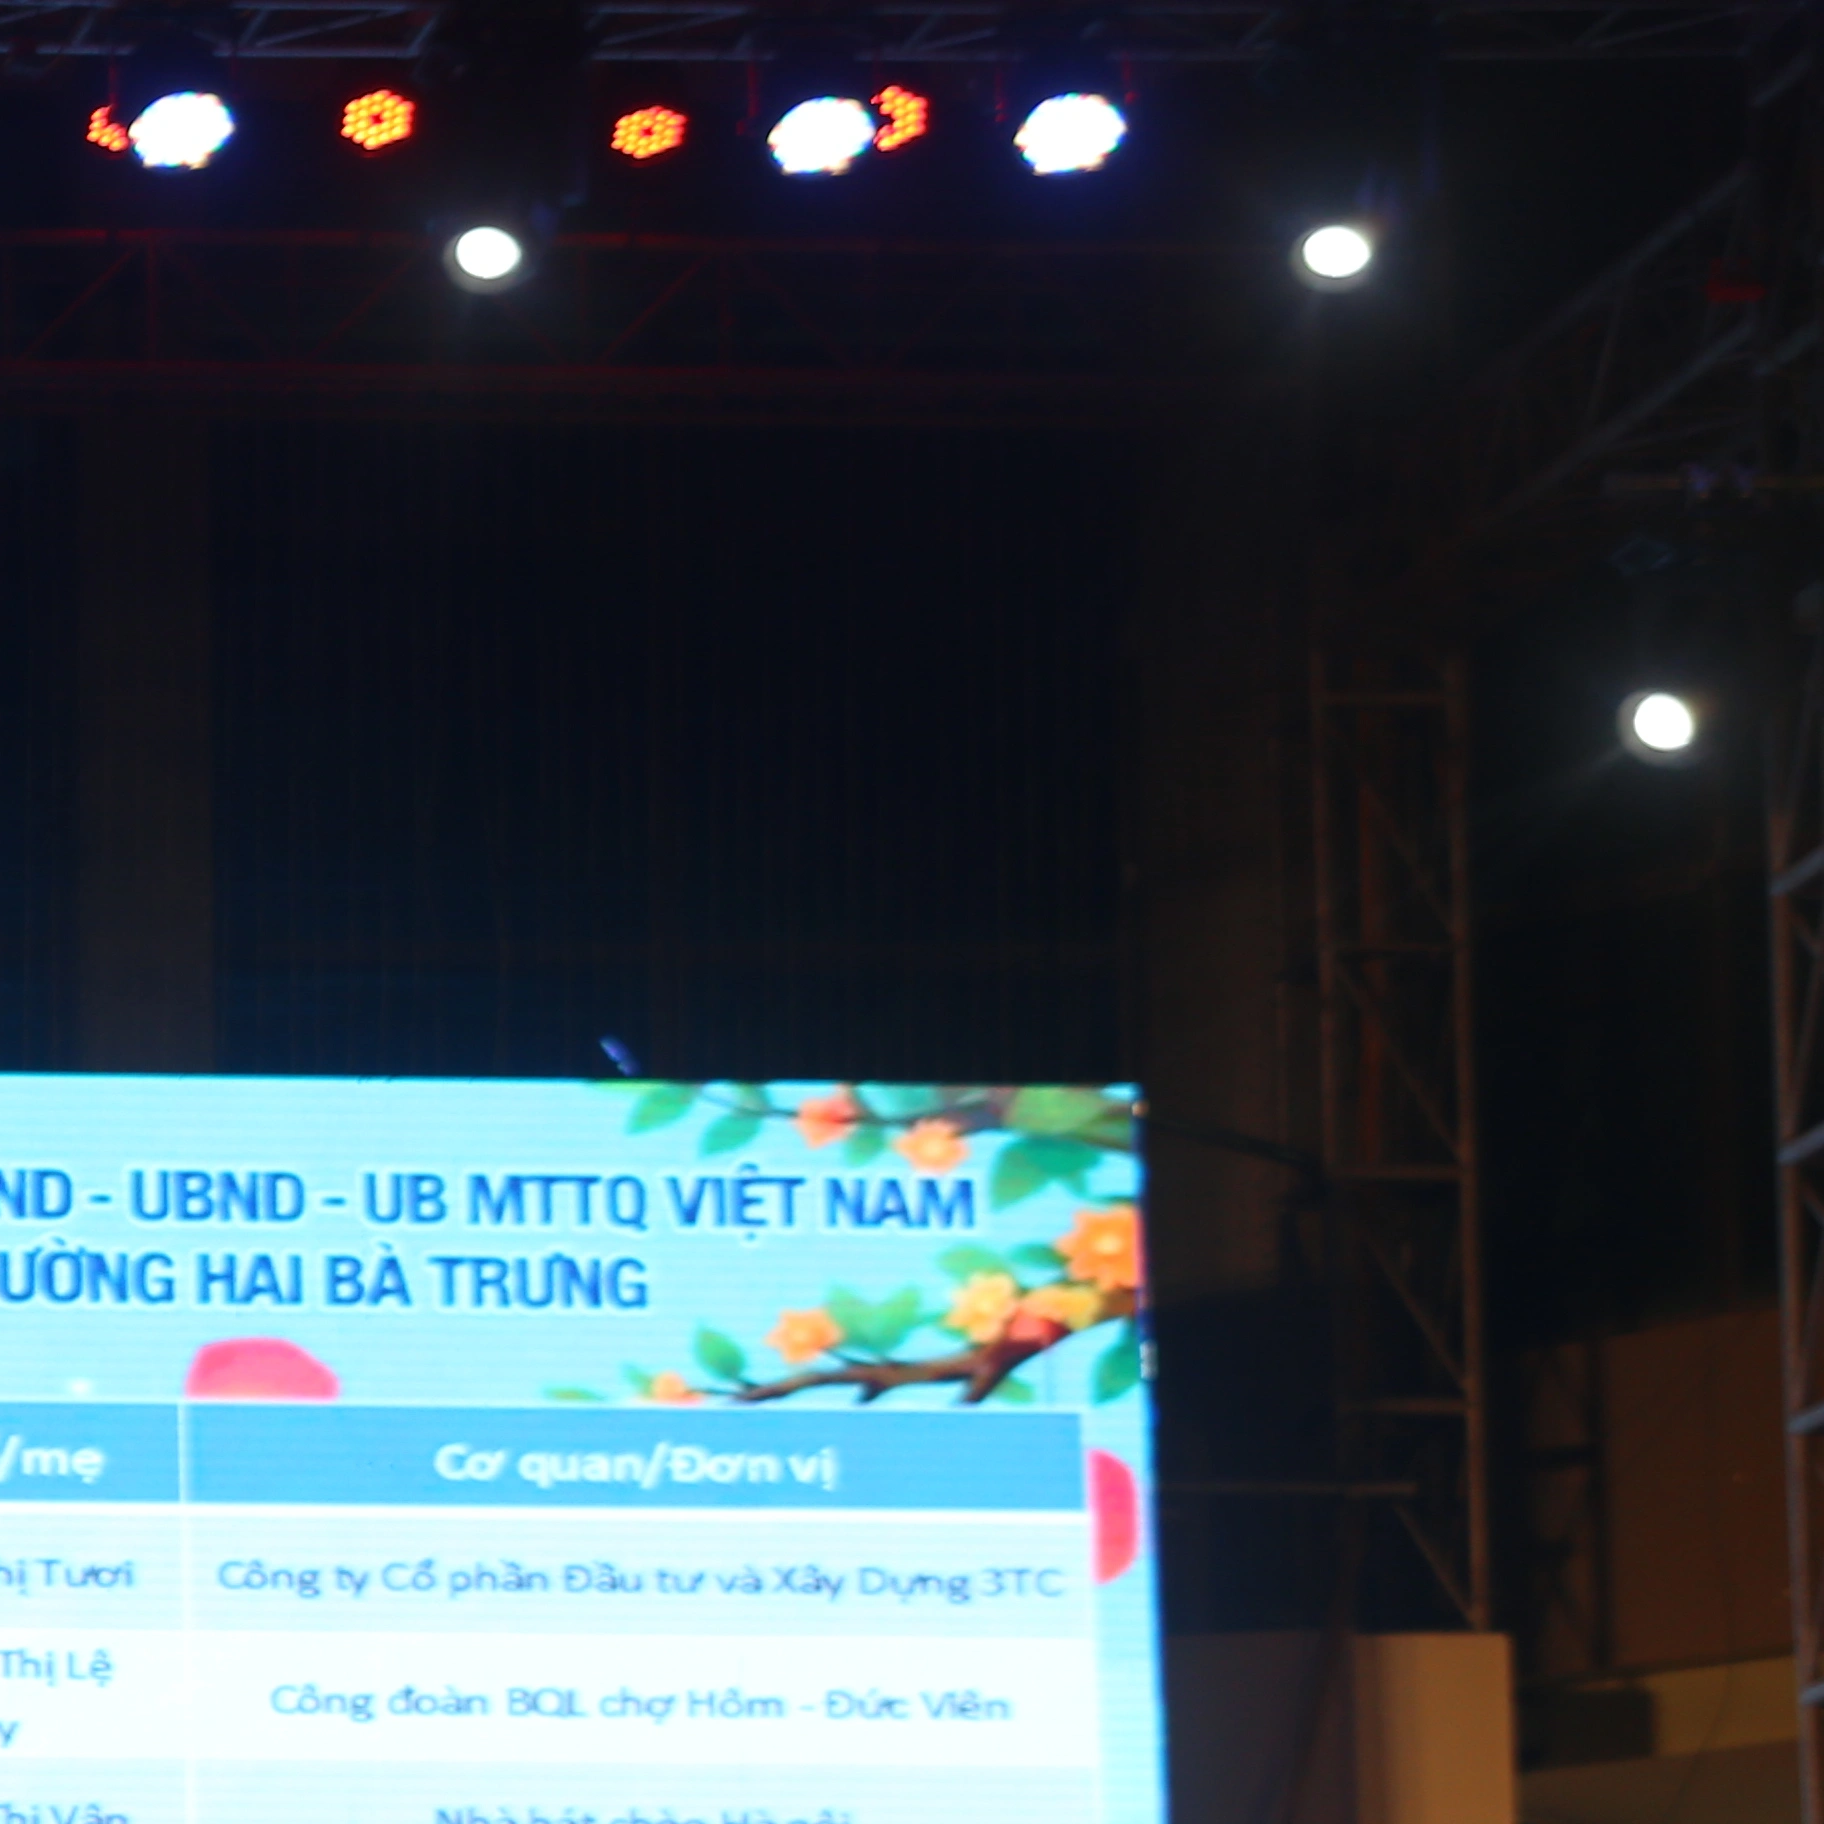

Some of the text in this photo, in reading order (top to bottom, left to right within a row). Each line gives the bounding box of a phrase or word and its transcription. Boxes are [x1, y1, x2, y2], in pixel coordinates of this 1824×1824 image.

[90, 1193, 113, 1205] -
[131, 1168, 307, 1224] UBND
[323, 1196, 347, 1207] -
[364, 1171, 449, 1225] UB
[468, 1172, 649, 1233] MTTQ
[664, 1161, 807, 1241] VIỆT
[825, 1176, 976, 1230] NAM
[197, 1252, 305, 1306] HAI
[325, 1242, 413, 1308] BÀ
[428, 1252, 649, 1310] TRƯNG
[433, 1440, 839, 1492] Cơ quan/Đơn vị
[35, 1556, 137, 1590] Tươi
[216, 1557, 325, 1601] Công
[332, 1564, 372, 1600] ty
[448, 1559, 553, 1600] phần
[561, 1560, 647, 1595] Đầu
[714, 1565, 768, 1597] và
[982, 1565, 1064, 1599] 3TC
